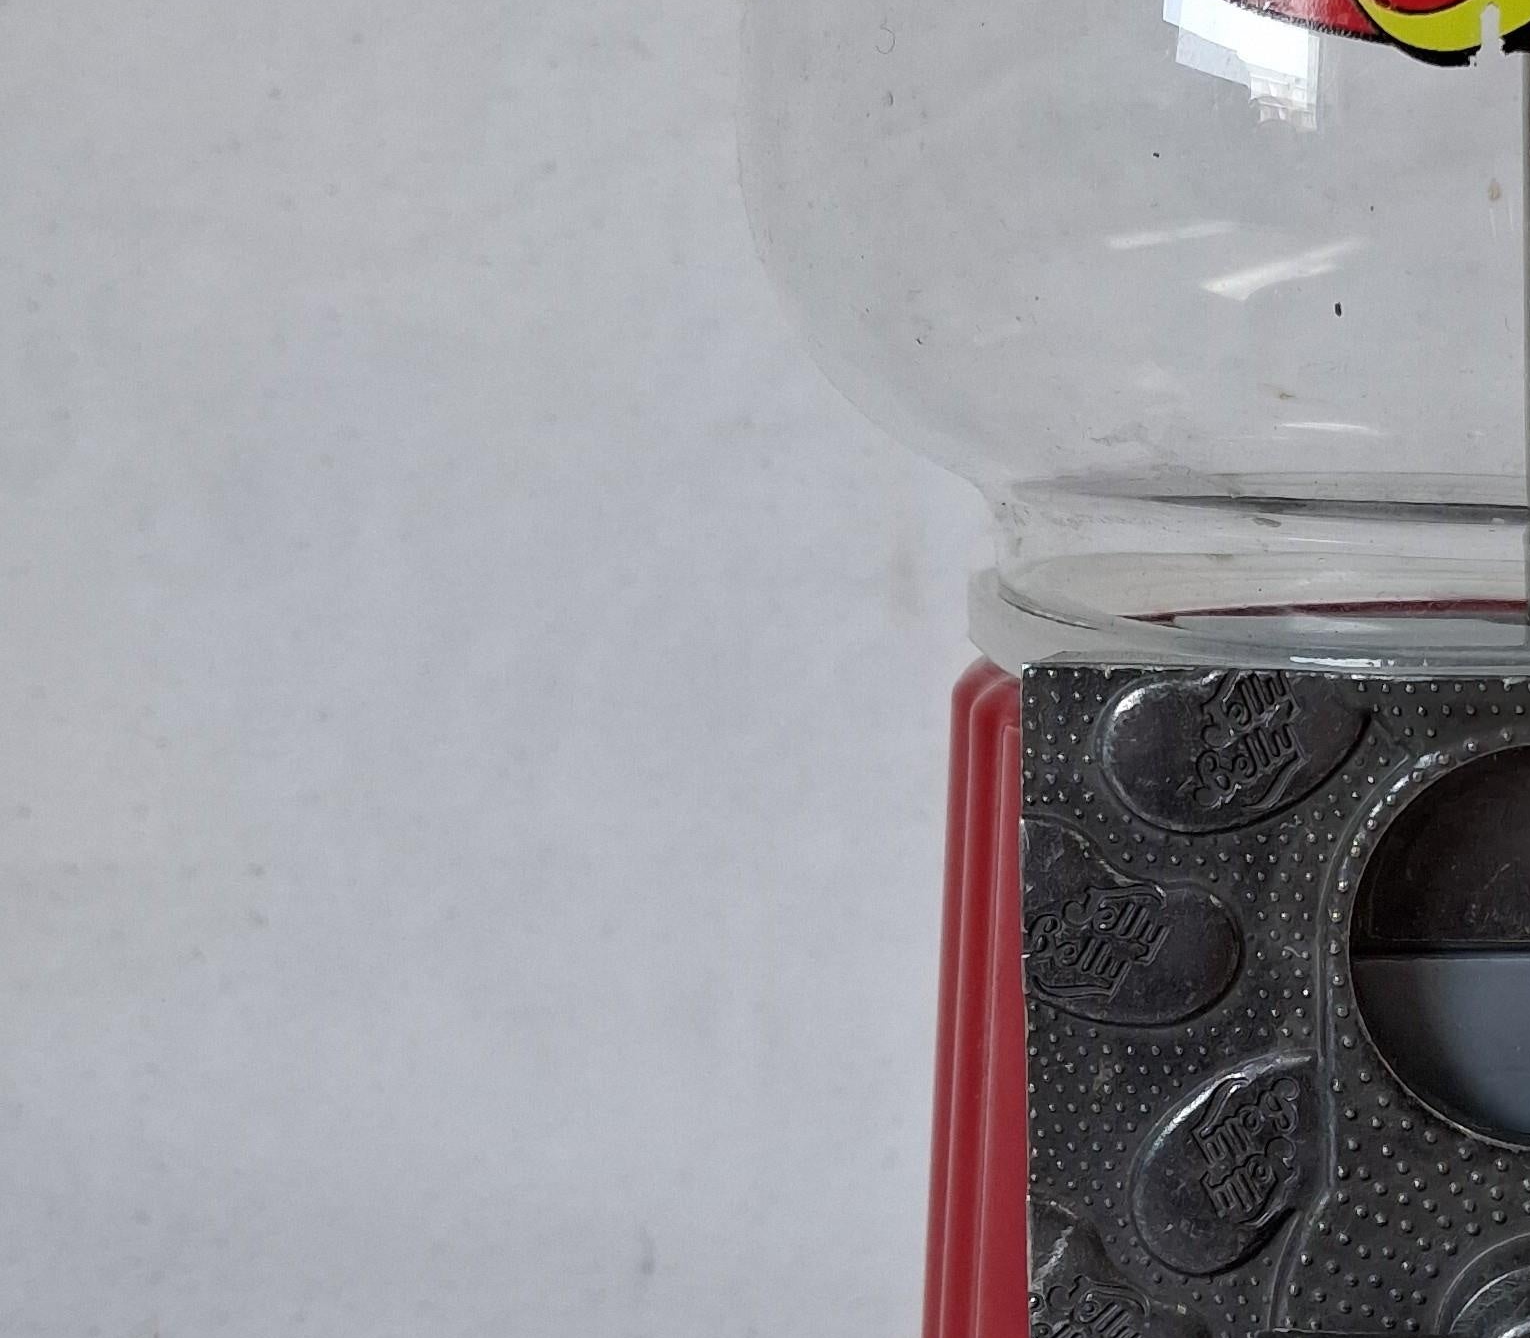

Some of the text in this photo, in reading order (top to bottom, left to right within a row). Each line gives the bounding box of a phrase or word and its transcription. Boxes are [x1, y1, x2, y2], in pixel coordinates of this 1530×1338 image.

[1200, 669, 1301, 749] Jelly
[1193, 723, 1310, 809] Belly
[1062, 883, 1170, 967] Jelly
[1191, 1076, 1299, 1166] Belly
[1200, 1134, 1299, 1228] Jelly
